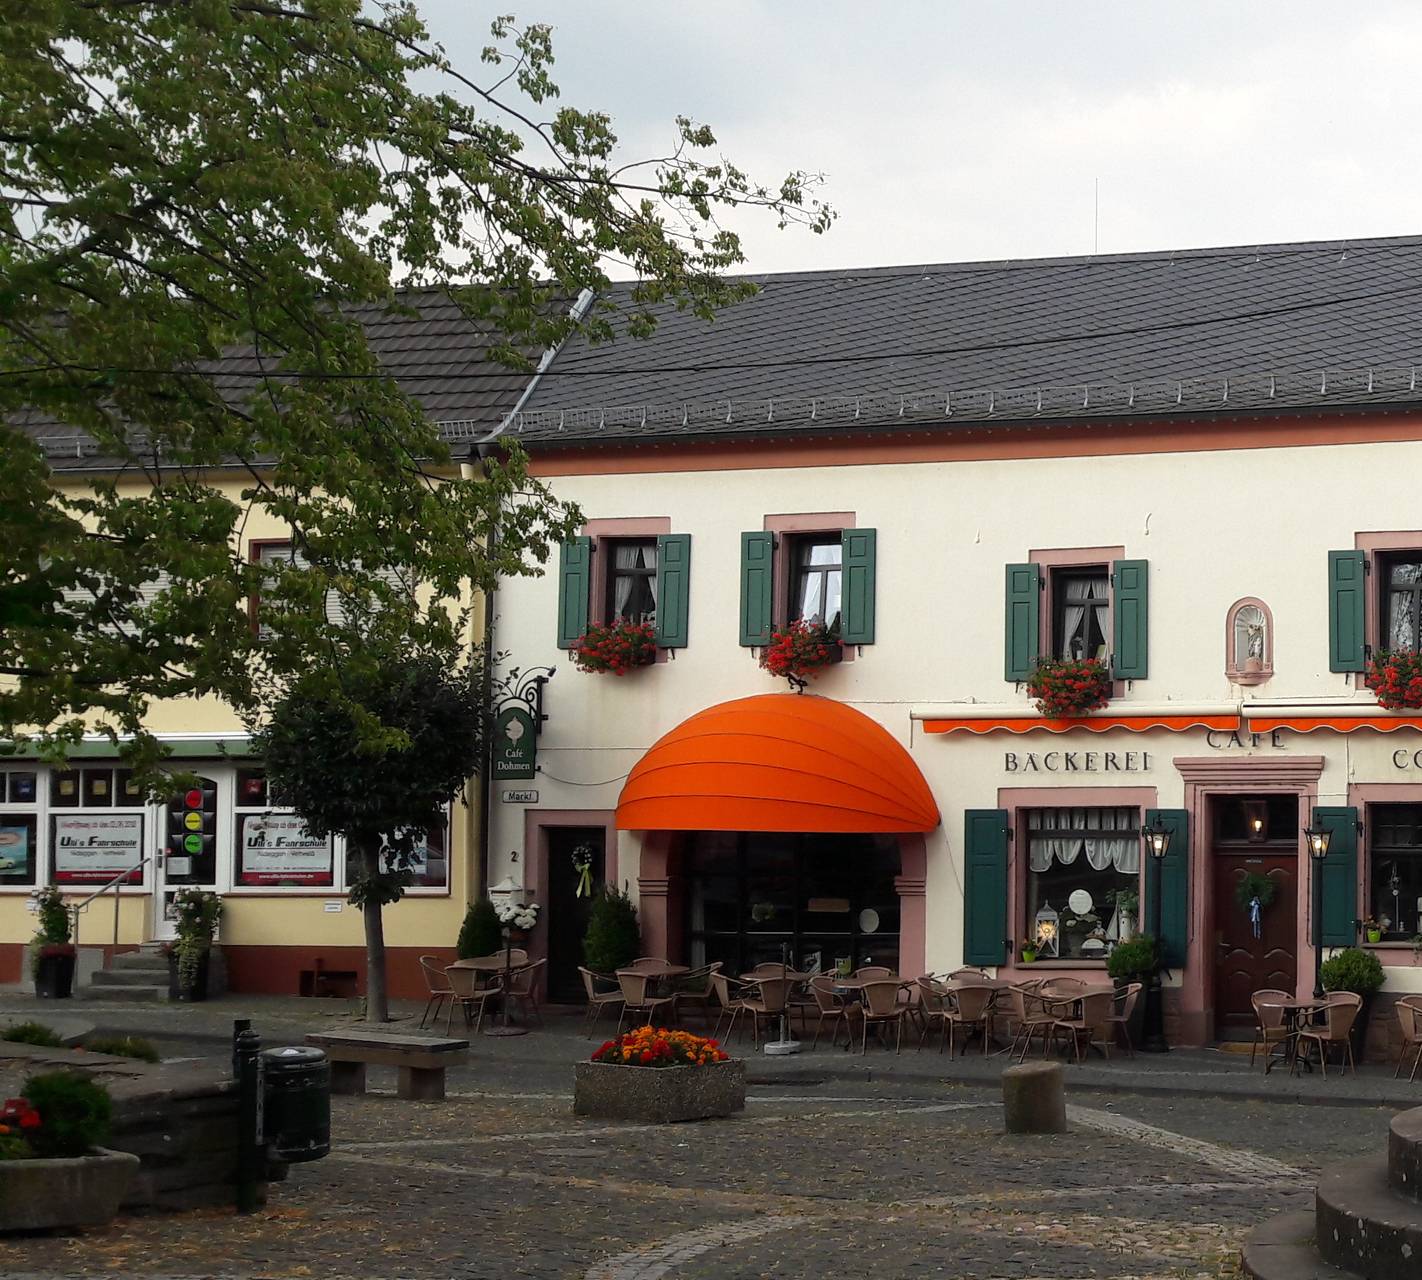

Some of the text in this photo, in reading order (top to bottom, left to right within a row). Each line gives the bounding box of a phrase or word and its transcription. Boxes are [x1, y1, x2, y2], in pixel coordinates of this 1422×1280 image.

[505, 748, 523, 758] Café
[497, 761, 530, 771] Dohmen
[1004, 751, 1150, 772] BÄCKEREI
[275, 836, 328, 847] Fahrschule
[510, 850, 518, 863] 2
